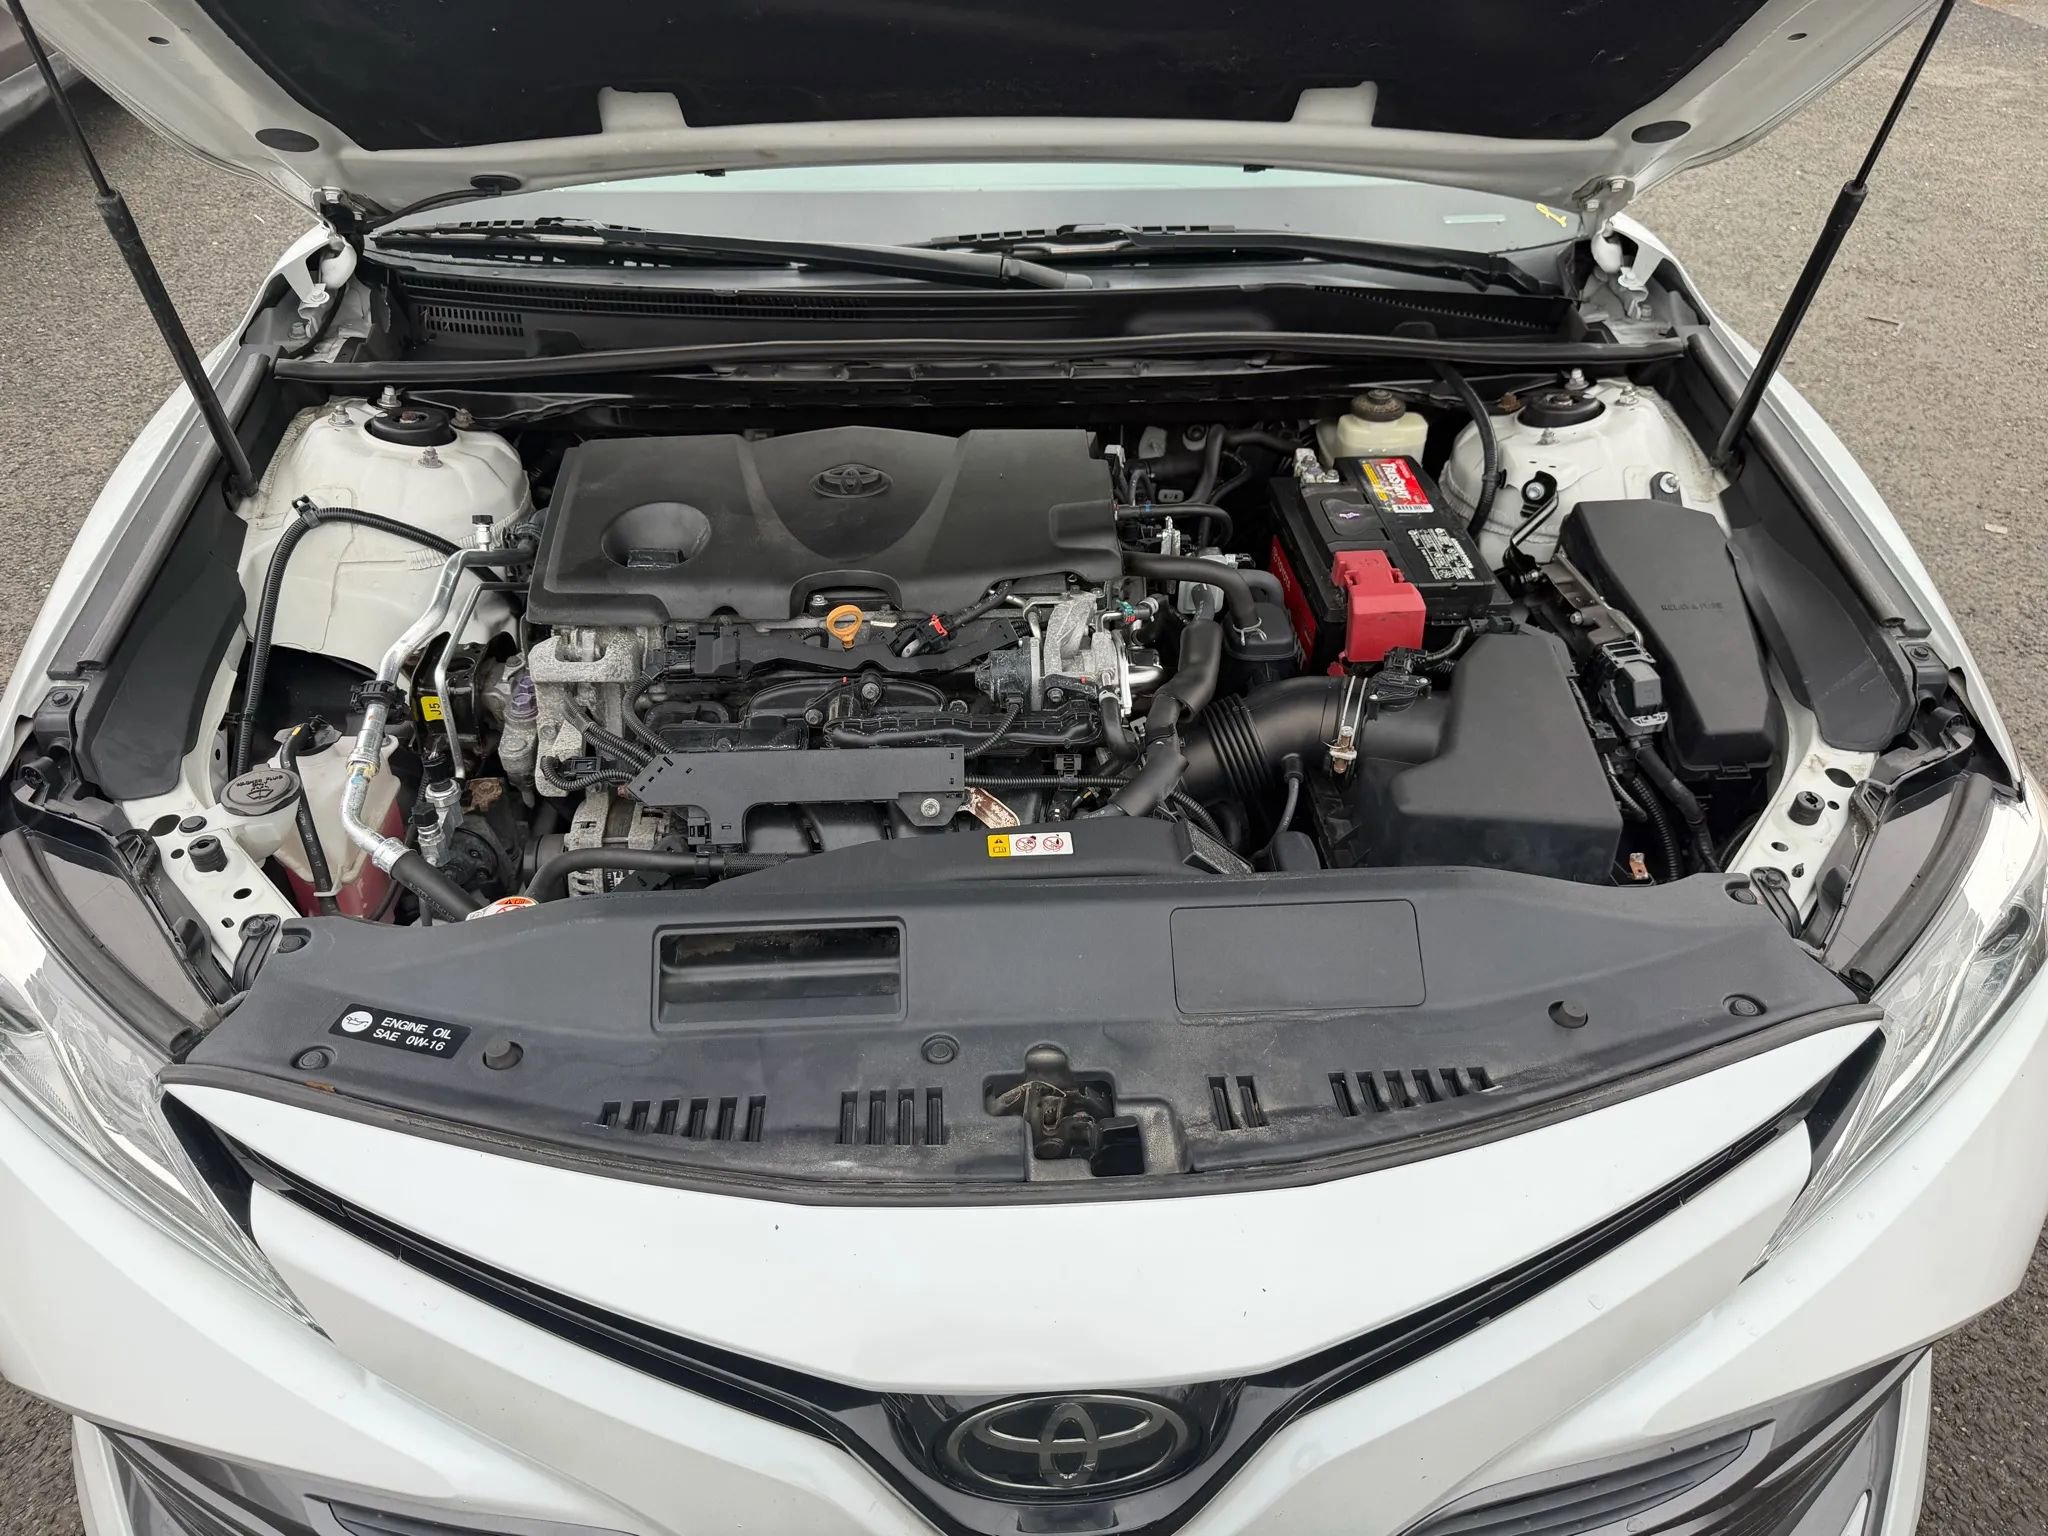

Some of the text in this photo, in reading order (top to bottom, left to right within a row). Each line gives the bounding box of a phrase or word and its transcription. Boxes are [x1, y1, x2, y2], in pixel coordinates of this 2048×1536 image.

[381, 1016, 452, 1039] ENGINE OIL
[373, 1028, 446, 1051] SAE 0W-16
